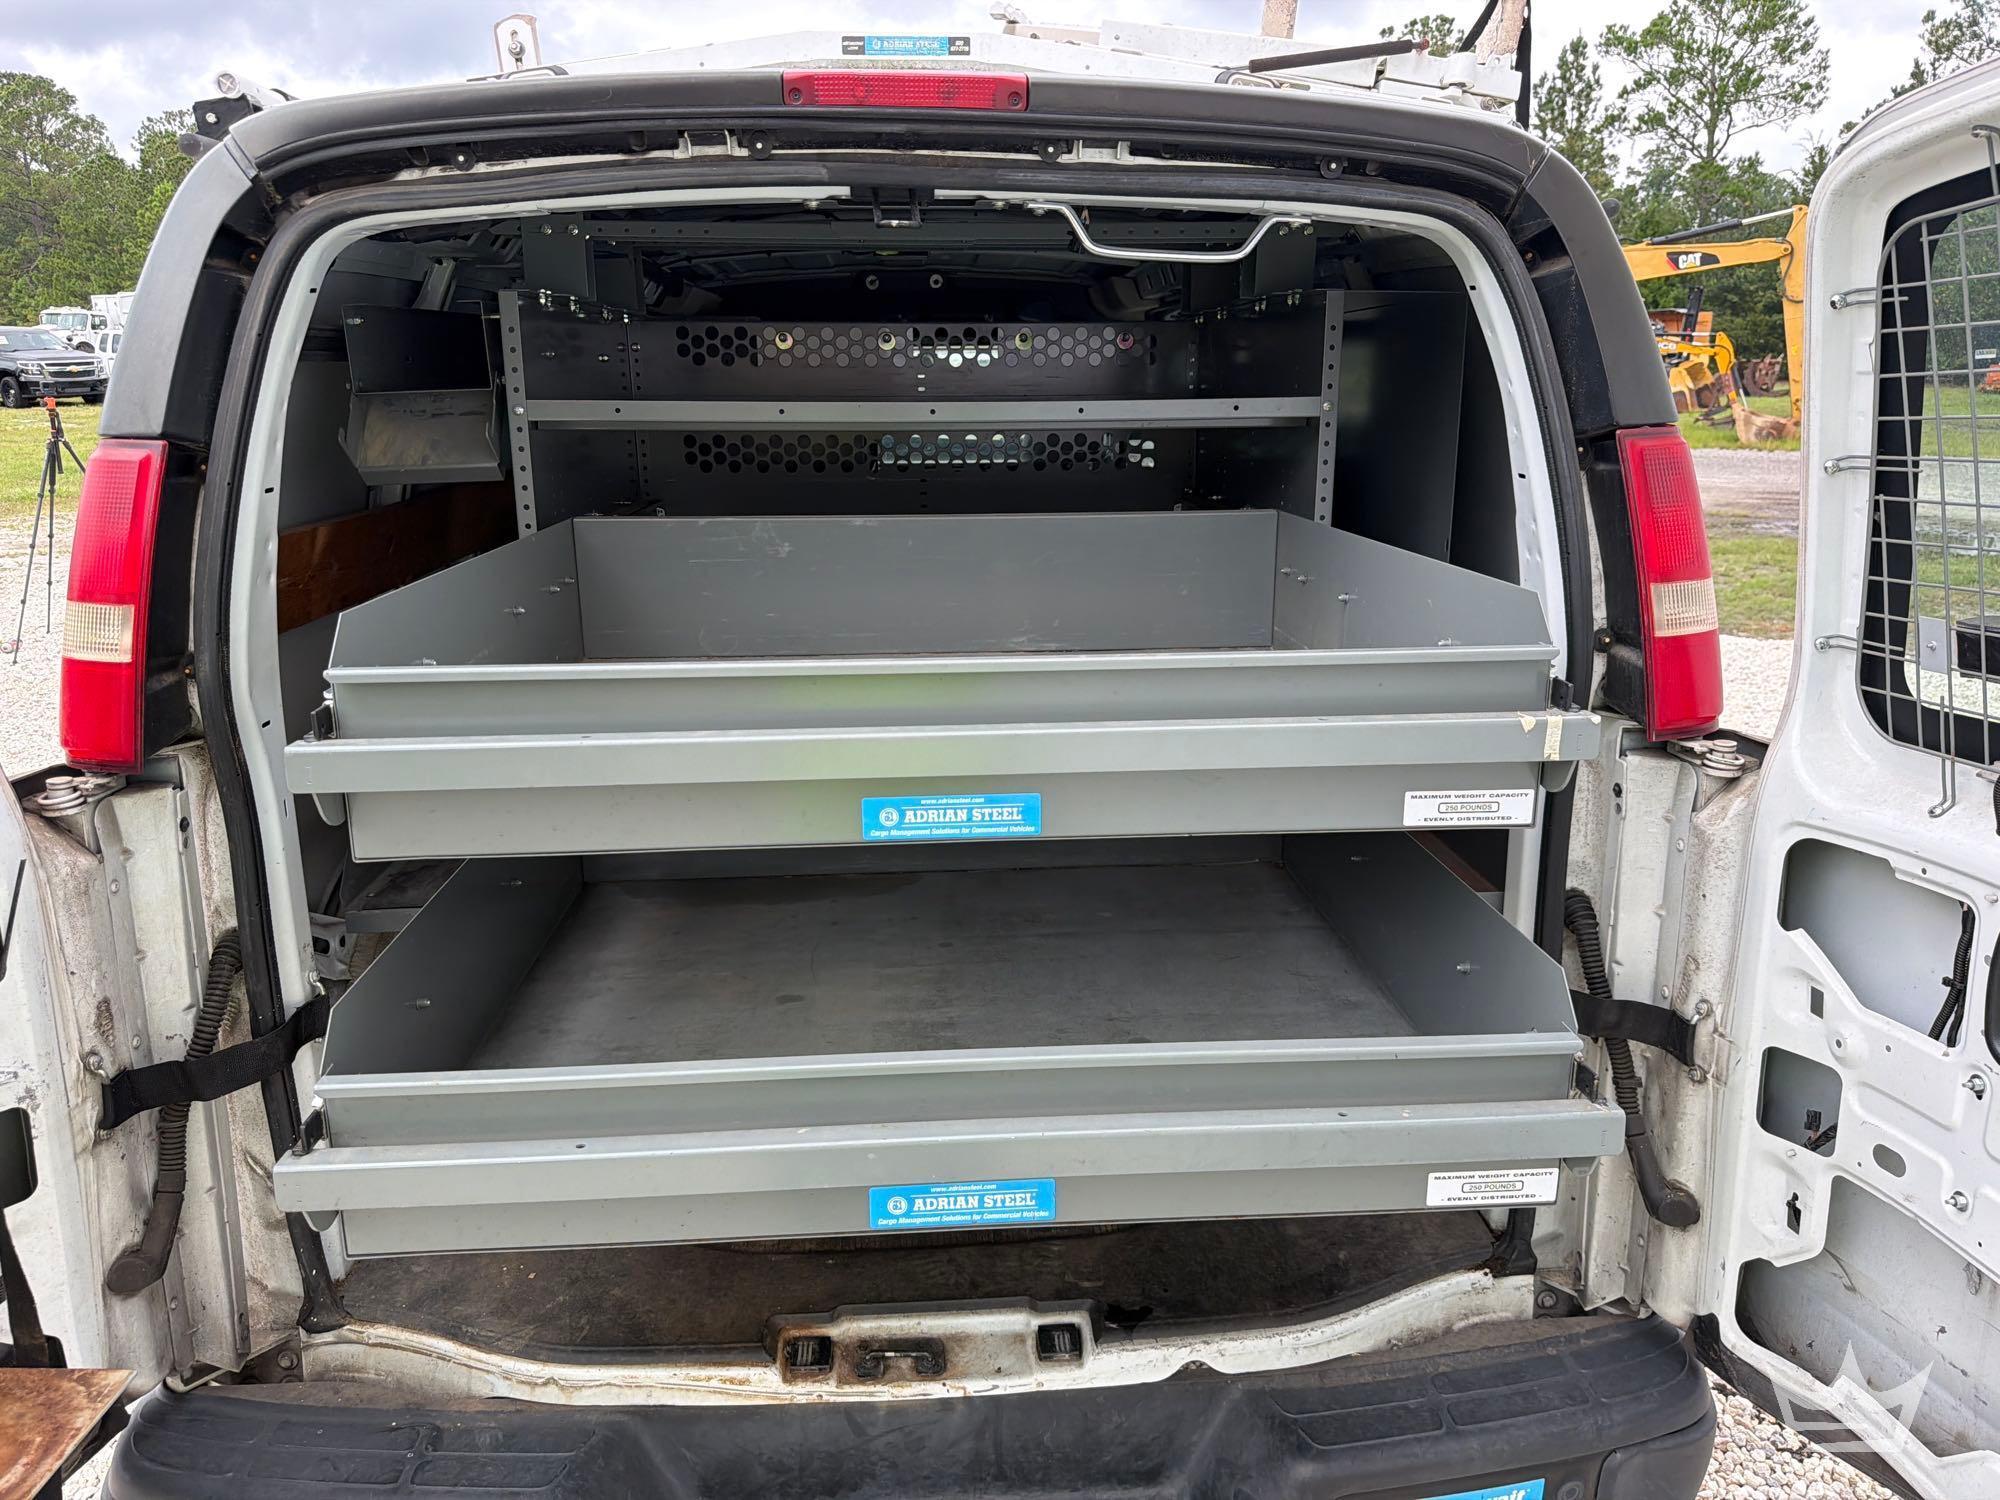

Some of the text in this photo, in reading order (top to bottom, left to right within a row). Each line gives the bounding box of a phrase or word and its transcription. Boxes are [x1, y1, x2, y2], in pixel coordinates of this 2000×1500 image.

[1678, 252, 1702, 269] CAT
[904, 807, 1022, 823] ADRIAN STEEL
[870, 829, 889, 837] Cargo
[890, 828, 930, 836] Management
[931, 827, 960, 835] Solutions
[972, 825, 1009, 833] Commercial
[930, 1184, 997, 1192] www.adriansteel.com
[913, 1193, 1036, 1211] ADRIAN STEEL
[877, 1218, 897, 1226] Cargo
[898, 1216, 941, 1224] Management
[941, 1214, 971, 1222] Solutions
[1022, 1210, 1049, 1218] Vehicles
